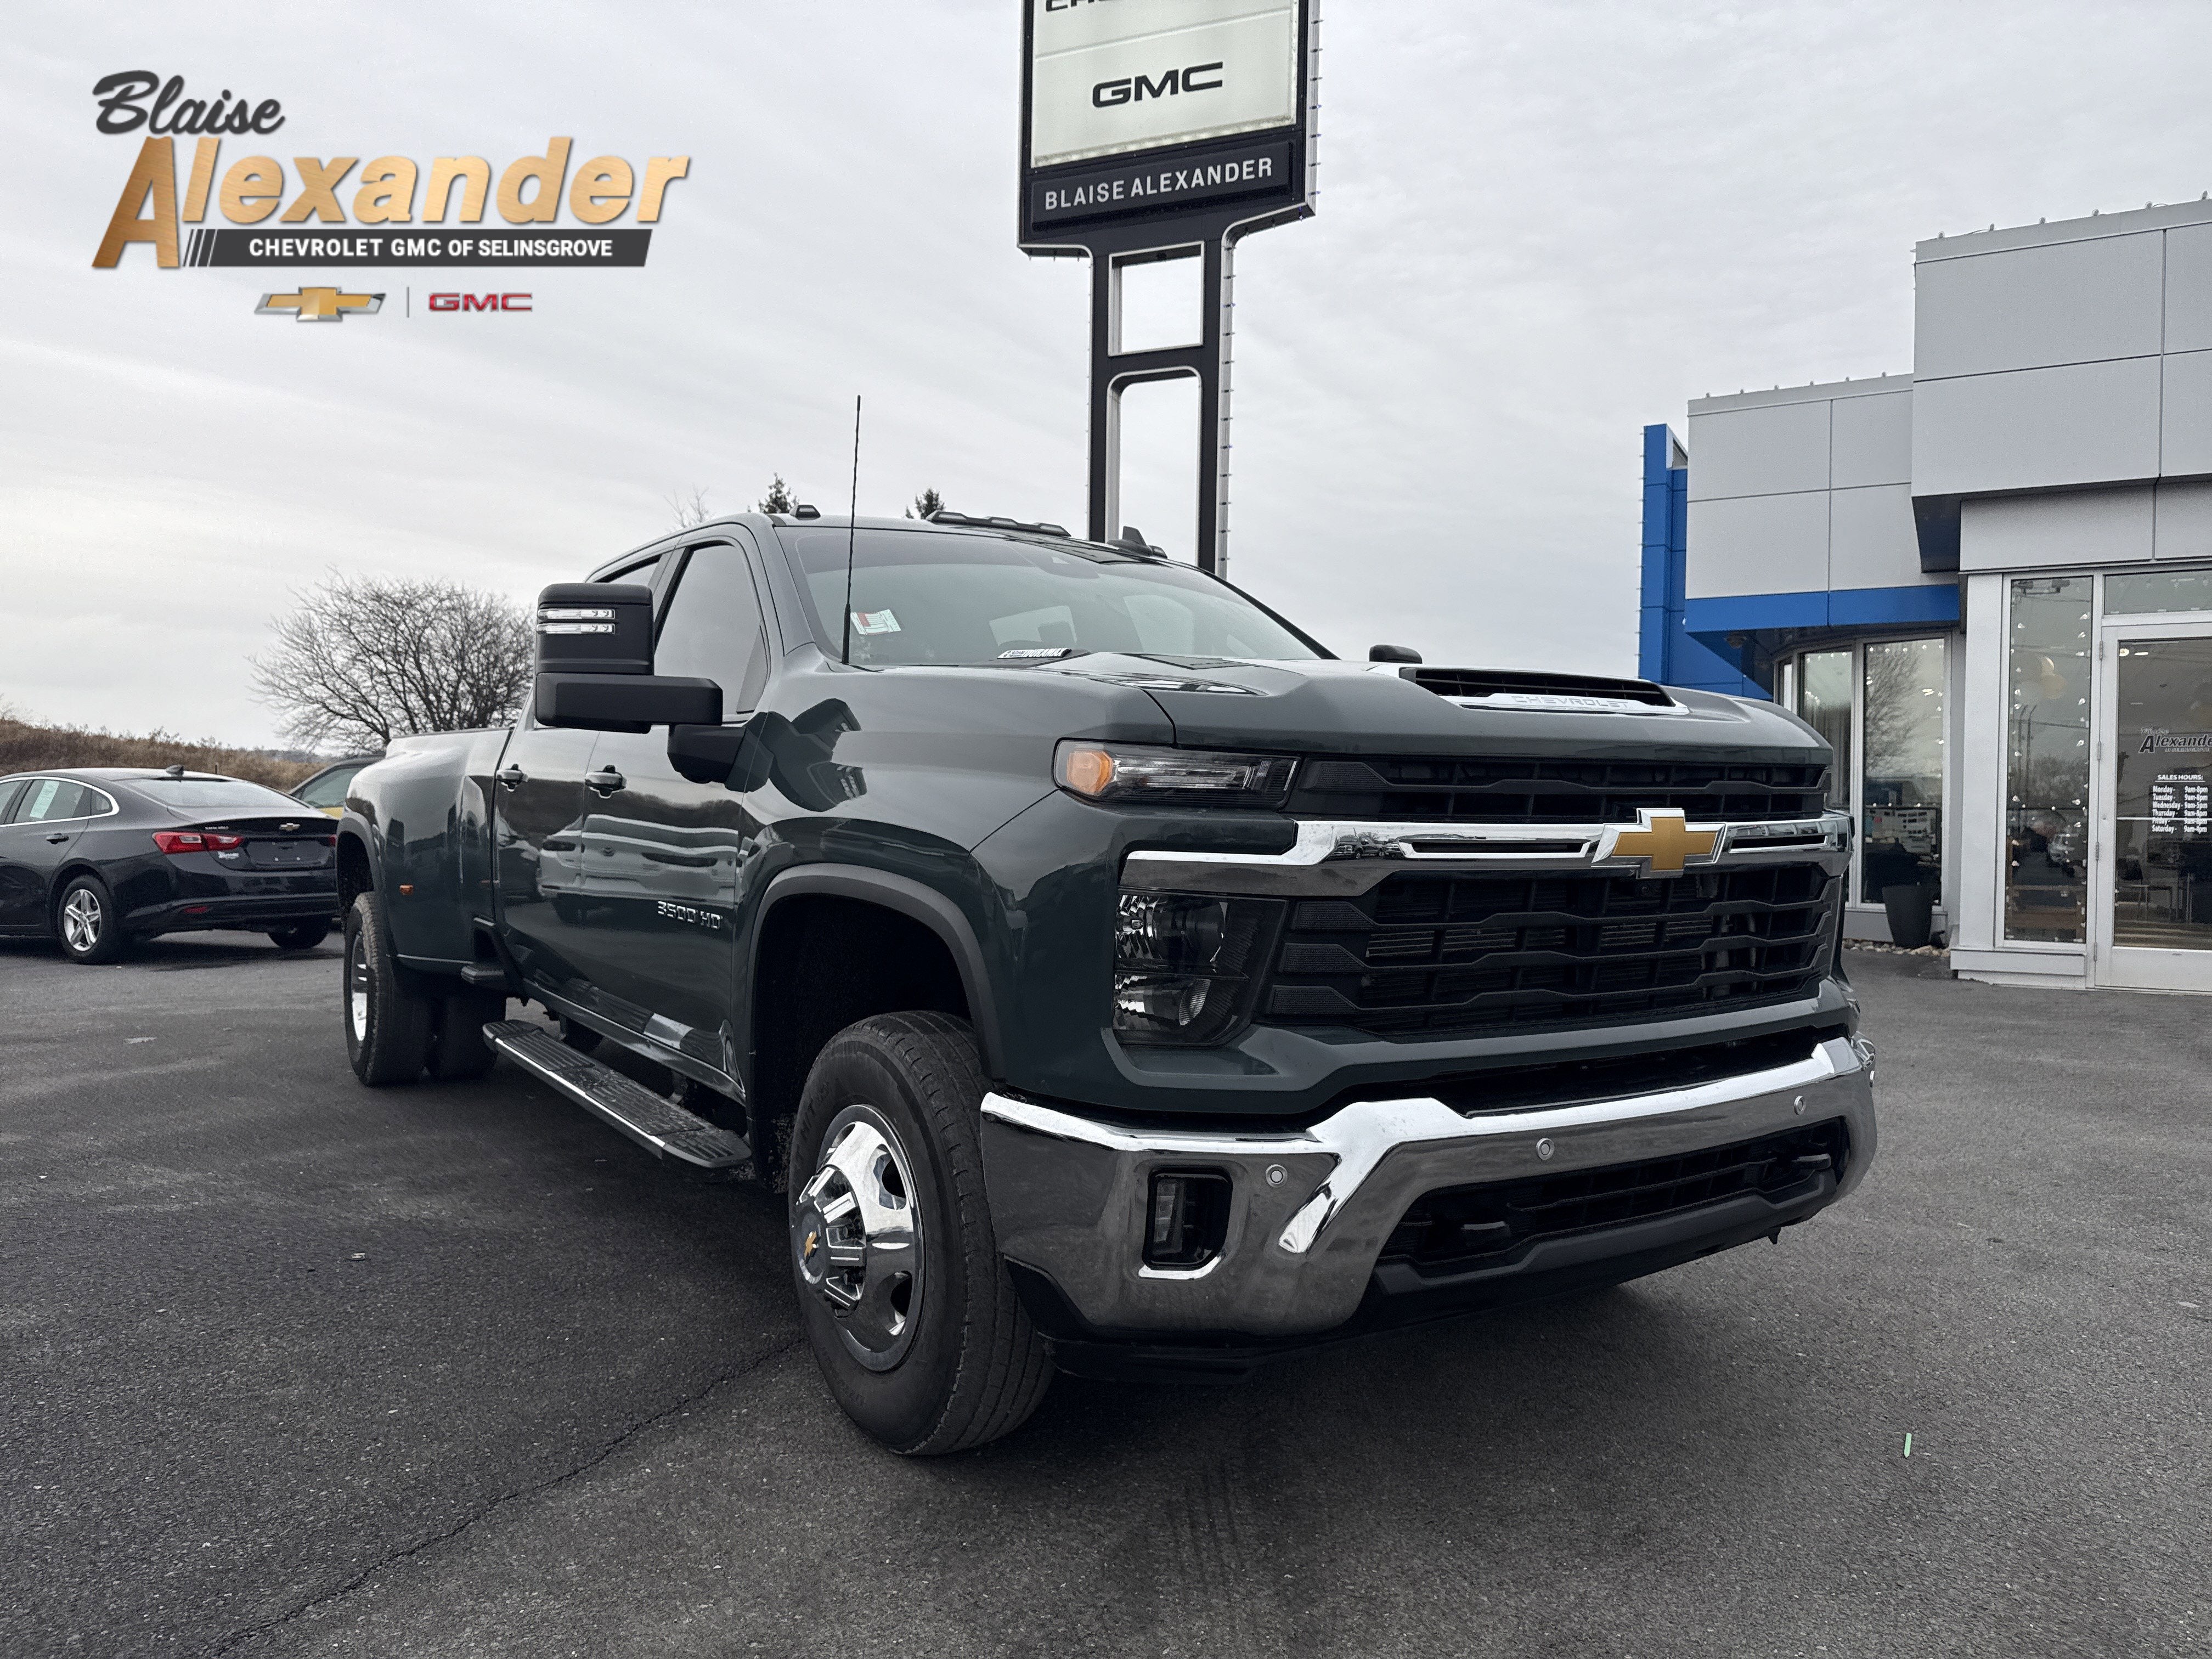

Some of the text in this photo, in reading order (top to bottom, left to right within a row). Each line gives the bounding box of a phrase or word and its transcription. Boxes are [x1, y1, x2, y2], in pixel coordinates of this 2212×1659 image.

[1092, 61, 1223, 108] GMC
[1045, 157, 1272, 210] BLAISE ALEXANDER
[1511, 696, 1628, 708] CHEVROLET
[658, 900, 723, 929] 3500 HD
